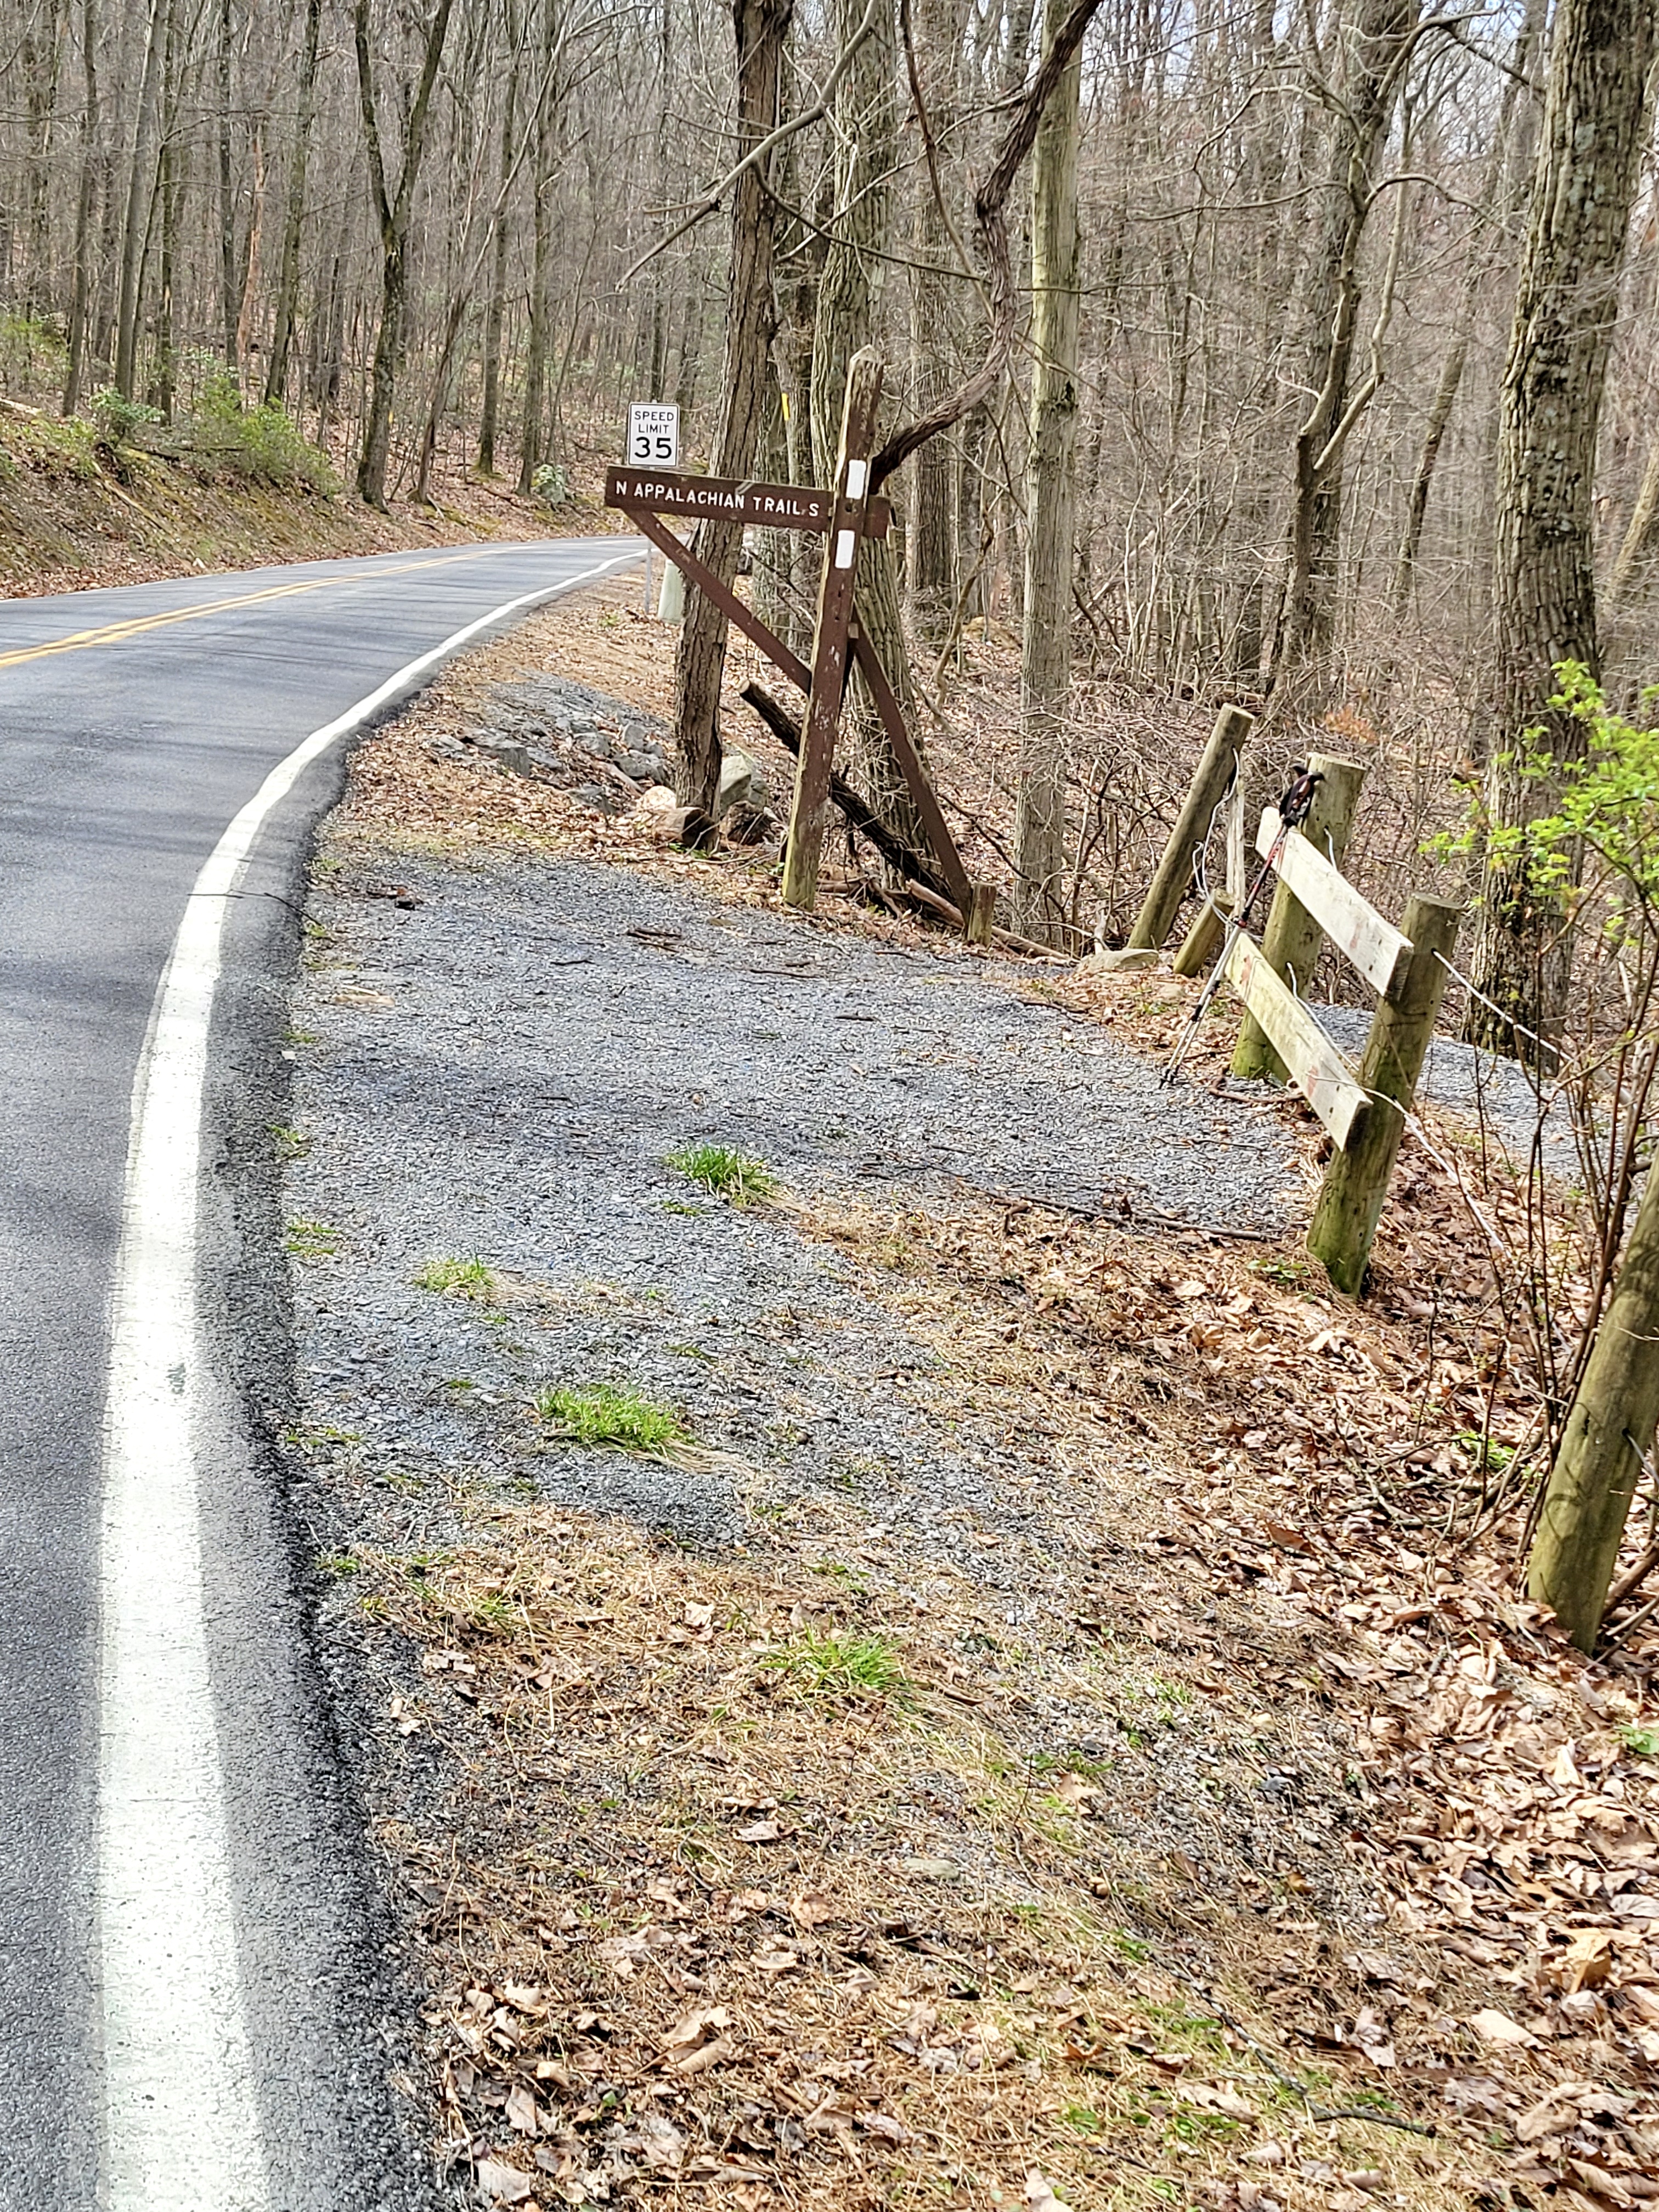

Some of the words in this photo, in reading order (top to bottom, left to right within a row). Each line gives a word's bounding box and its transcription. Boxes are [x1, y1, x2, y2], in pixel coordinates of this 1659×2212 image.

[634, 410, 674, 421] SPEED
[639, 424, 669, 434] LIMIT
[634, 436, 672, 459] 35
[616, 481, 627, 495] N
[634, 483, 744, 509] APPALACHIAN
[753, 496, 801, 516] TRAIL
[809, 503, 819, 517] S
